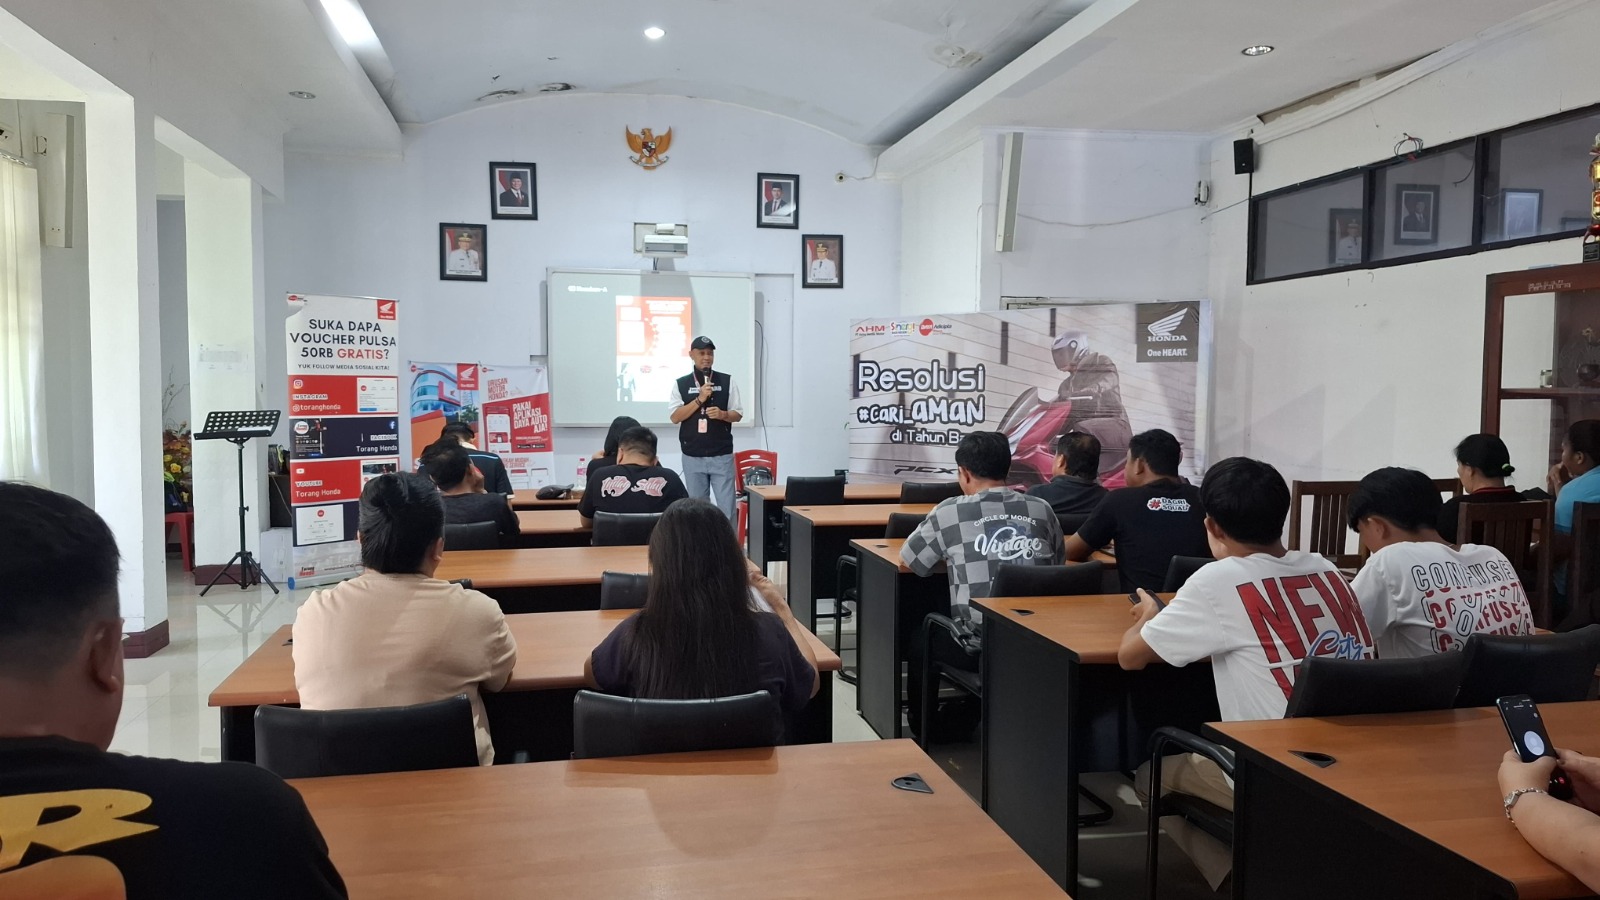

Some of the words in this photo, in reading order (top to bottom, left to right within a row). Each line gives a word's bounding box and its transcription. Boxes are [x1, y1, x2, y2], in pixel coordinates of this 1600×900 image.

[309, 319, 344, 330] SUKA
[348, 321, 382, 332] DAPA
[290, 332, 355, 345] VOUCHER
[360, 335, 396, 347] PULSA
[300, 347, 333, 358] 50RB
[337, 348, 390, 360] GRATIS?
[856, 359, 985, 392] Resolusi
[512, 401, 531, 412] PAKAI
[514, 408, 541, 420] APLIKASI
[514, 418, 530, 429] DAYA
[531, 414, 548, 425] AUTO
[891, 427, 902, 444] di
[906, 428, 946, 444] Tahun
[974, 514, 998, 527] CIRCLE
[974, 526, 1042, 560] Vintage
[1236, 570, 1374, 664] NEW
[1308, 630, 1363, 660] City
